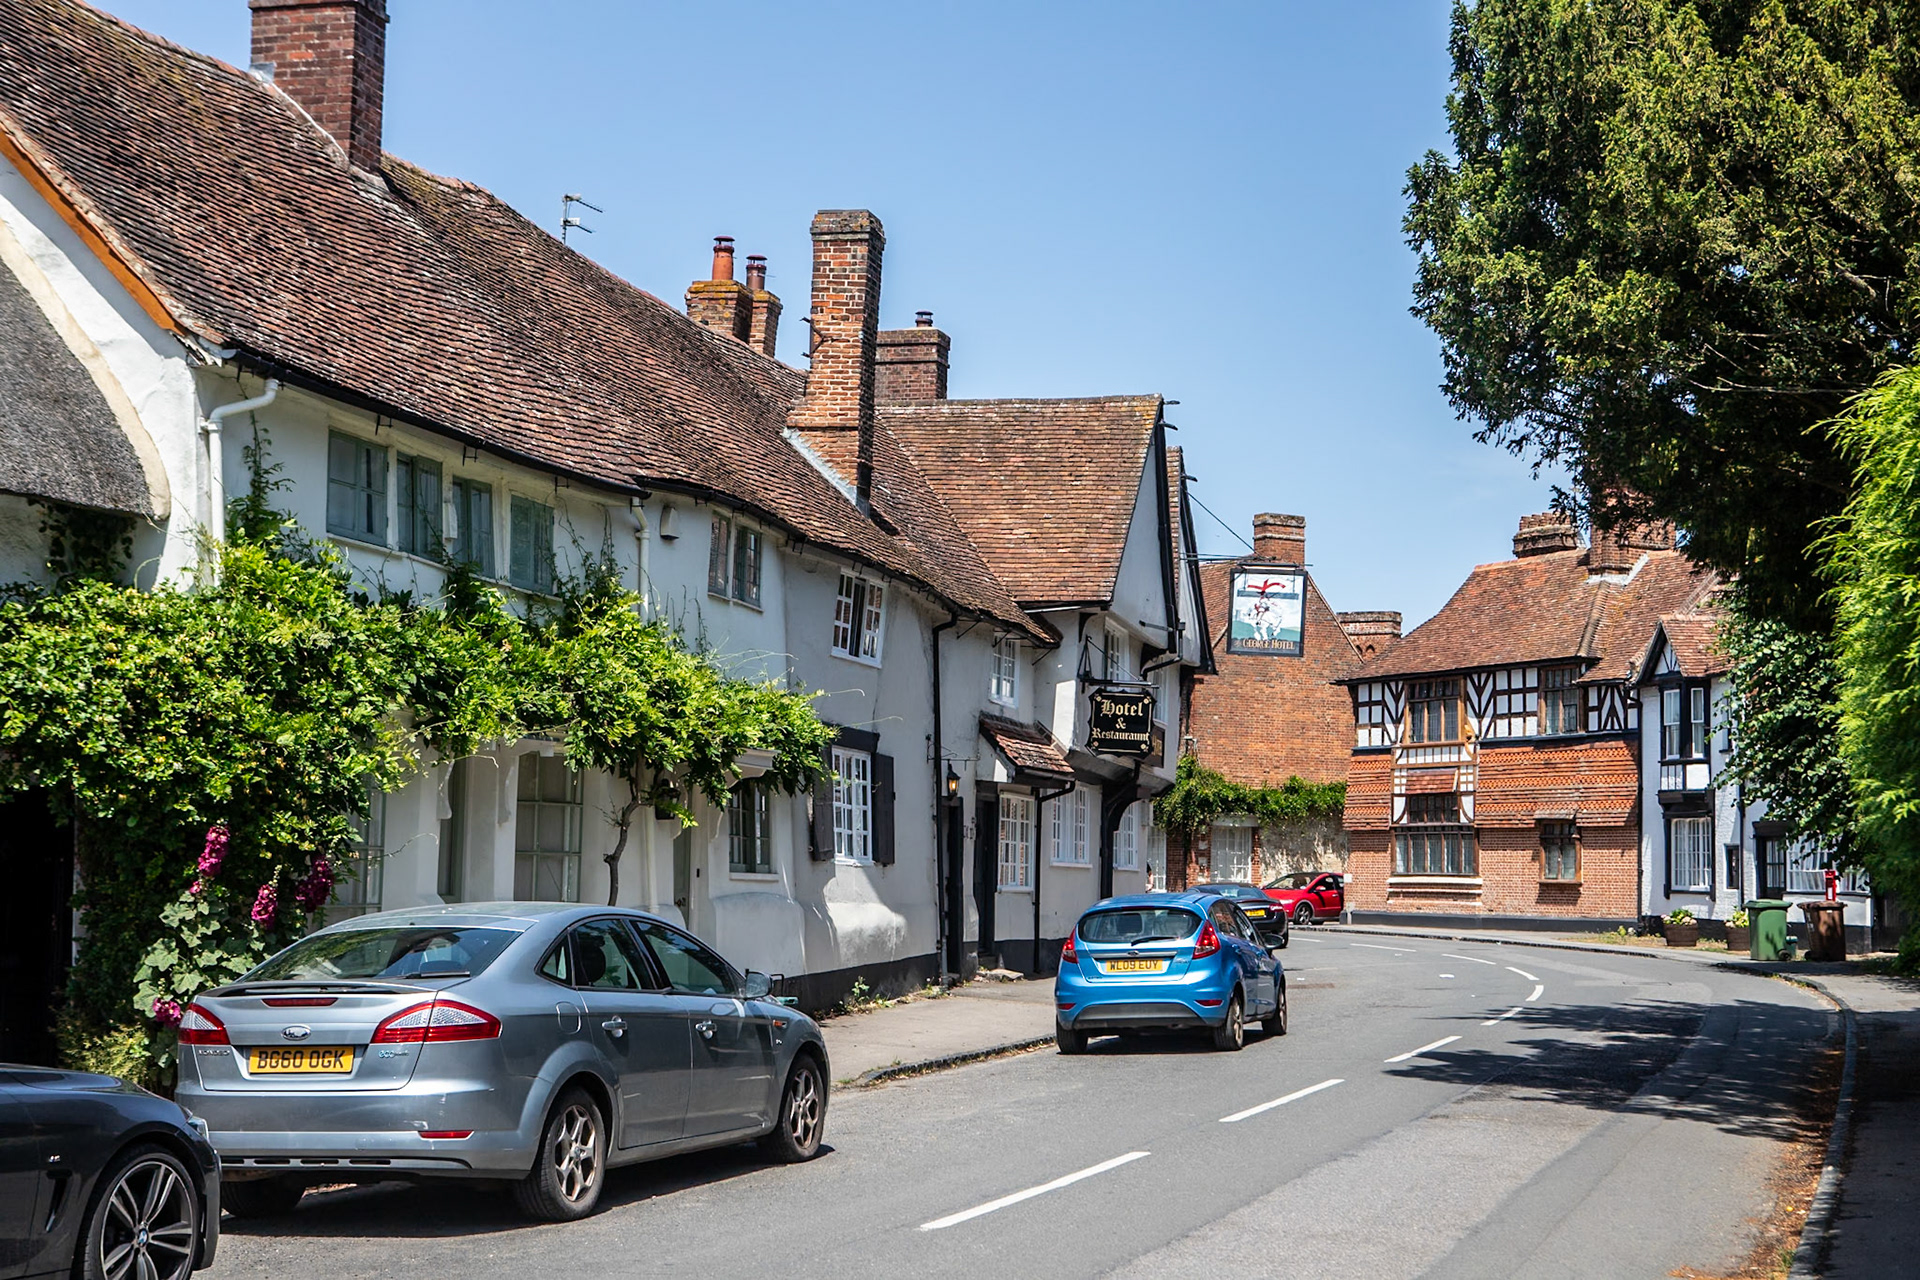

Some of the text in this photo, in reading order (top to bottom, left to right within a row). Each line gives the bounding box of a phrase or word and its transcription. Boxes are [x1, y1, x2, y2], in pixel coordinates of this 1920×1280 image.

[1242, 639, 1295, 650] GEORGE HOTEL
[1100, 699, 1144, 718] Hotel
[1115, 717, 1127, 730] &
[1110, 960, 1159, 971] WL09 EUY
[257, 1050, 346, 1069] BG60 OGK
